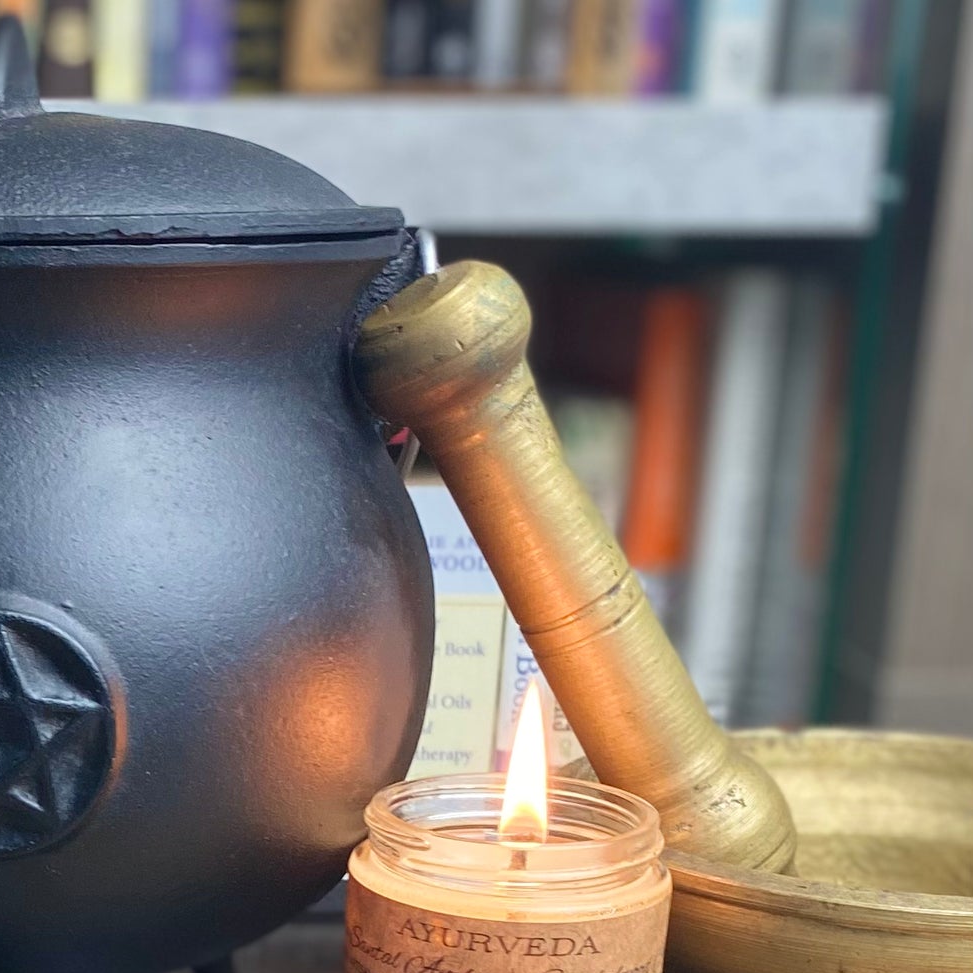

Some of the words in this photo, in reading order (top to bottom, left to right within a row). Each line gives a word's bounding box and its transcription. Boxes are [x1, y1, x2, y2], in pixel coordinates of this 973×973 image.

[445, 642, 486, 657] Book
[441, 694, 472, 710] Oils
[395, 918, 602, 957] AYURVEDA
